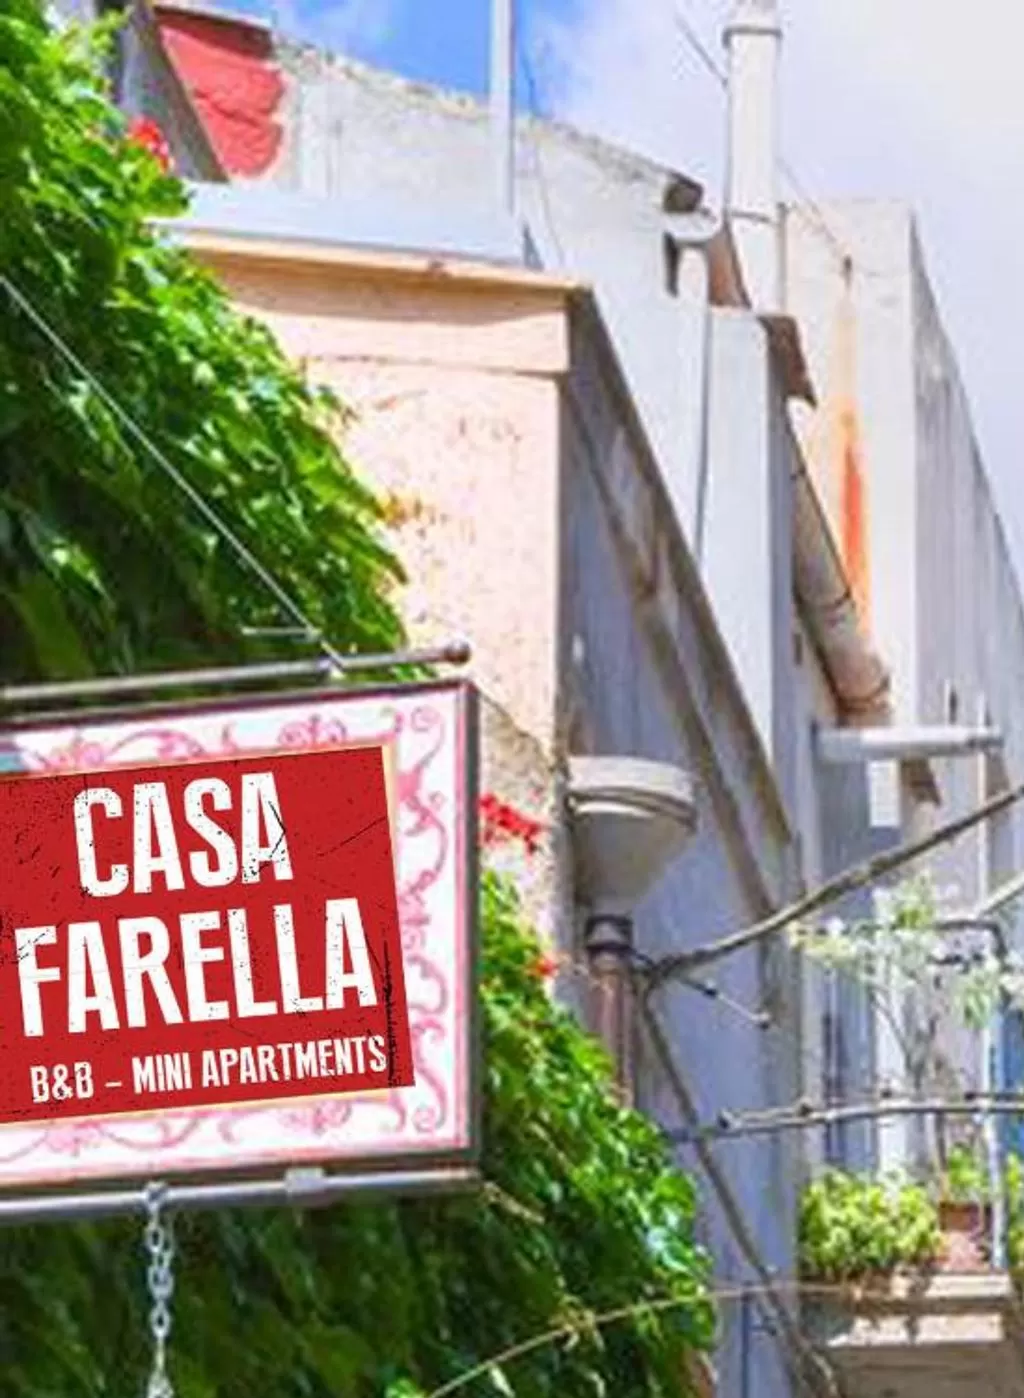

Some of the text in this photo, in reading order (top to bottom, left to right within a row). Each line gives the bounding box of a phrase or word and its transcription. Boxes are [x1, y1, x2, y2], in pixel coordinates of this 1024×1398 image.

[73, 771, 294, 898] CASA
[14, 897, 378, 1037] FARELLA
[29, 1060, 95, 1104] B&B
[132, 1051, 193, 1094] MINI
[201, 1034, 387, 1087] APARTMENTS
